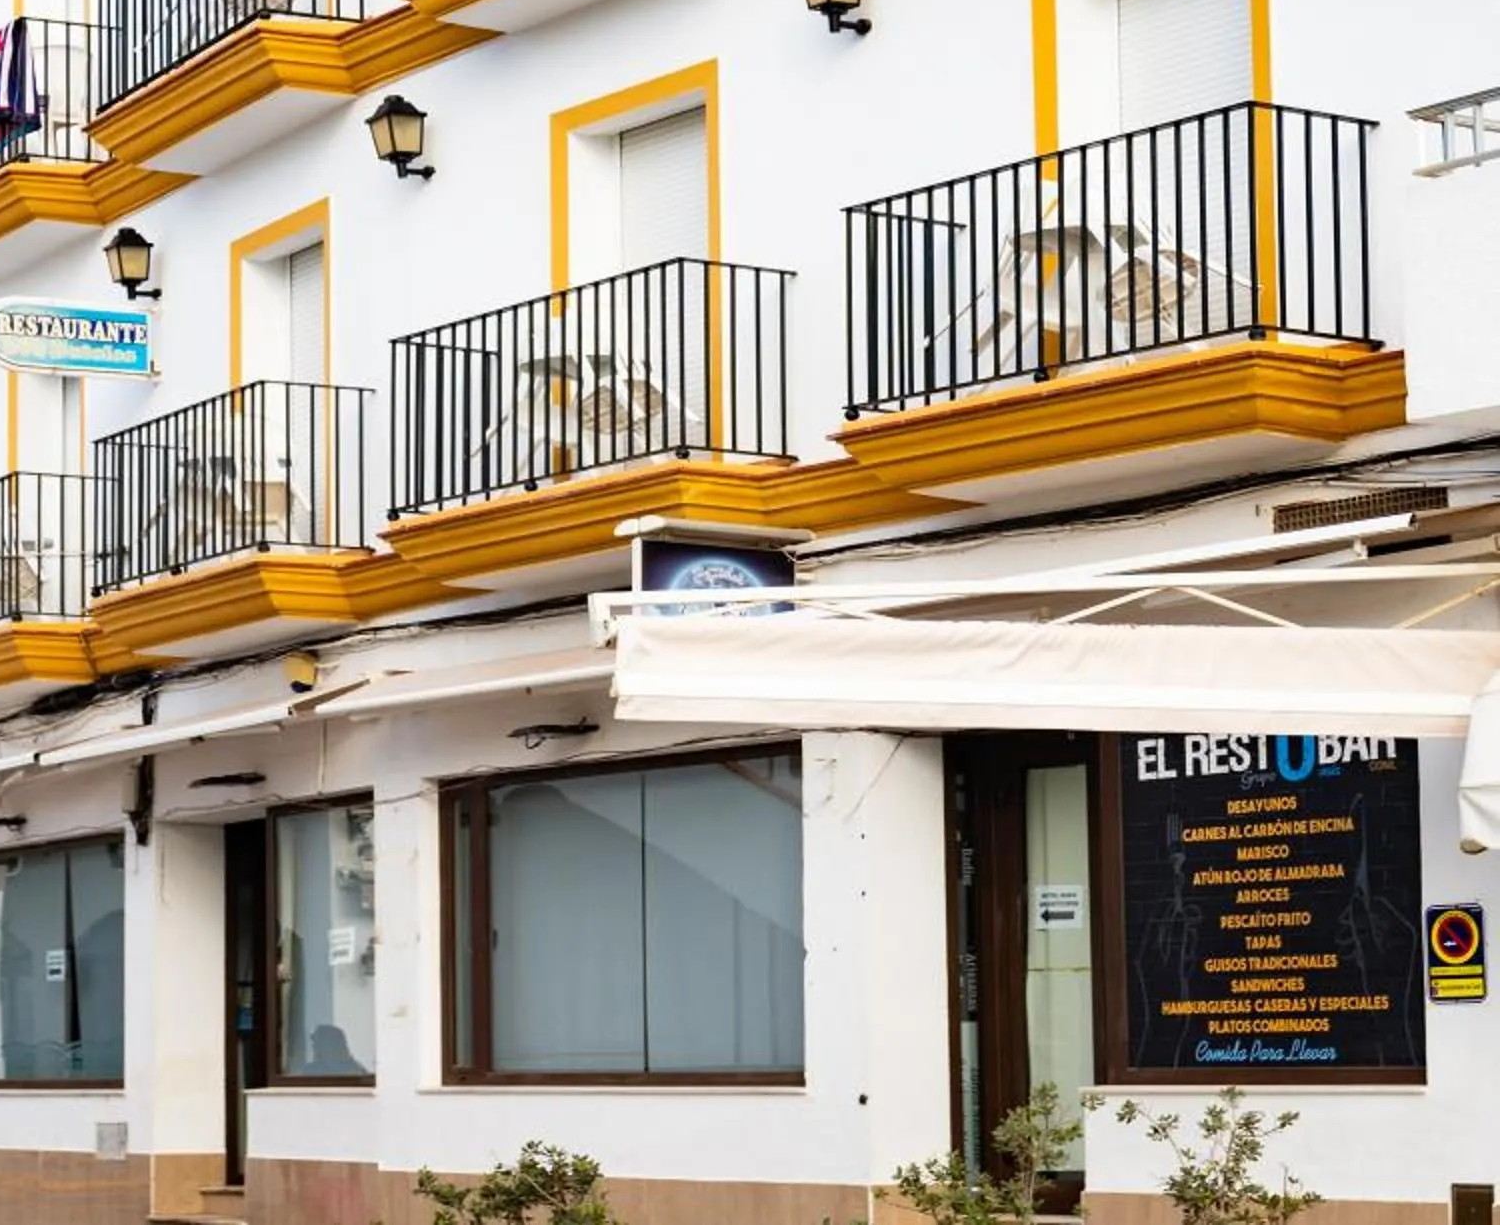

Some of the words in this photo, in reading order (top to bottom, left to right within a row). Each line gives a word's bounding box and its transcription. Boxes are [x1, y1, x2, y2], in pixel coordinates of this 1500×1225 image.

[1137, 738, 1178, 782] EL
[1227, 796, 1297, 814] DESAYUNOS
[1182, 825, 1227, 842] CARNES
[1228, 825, 1242, 839] AL
[1243, 819, 1292, 838] CARBÓN
[1293, 821, 1307, 835] DE
[1309, 817, 1354, 834] ENCINA
[1236, 845, 1290, 861] MARISCO
[1193, 867, 1223, 886] ATÚN
[1224, 870, 1257, 885] ROJO
[1258, 868, 1272, 882] DE
[1274, 864, 1345, 881] ALMADRABA
[1236, 887, 1290, 904] ARROCES
[1220, 910, 1276, 929] PESCAÍTO
[1278, 912, 1312, 926] FRITO
[1245, 935, 1282, 950] TAPAS
[1204, 957, 1247, 972] GUISOS
[1249, 954, 1339, 970] TRADICIONALES
[1230, 977, 1305, 993] SANDWICHES
[1161, 999, 1251, 1016] HAMBURGUESAS
[1255, 998, 1307, 1013] CASERAS
[1308, 998, 1317, 1012] Y
[1319, 995, 1389, 1011] ESPECIALES
[1208, 1020, 1252, 1035] PLATOS
[1253, 1018, 1330, 1033] COMBINADOS
[1195, 1039, 1248, 1063] Comida
[1249, 1039, 1285, 1062] Para
[1286, 1038, 1337, 1062] Llevar
